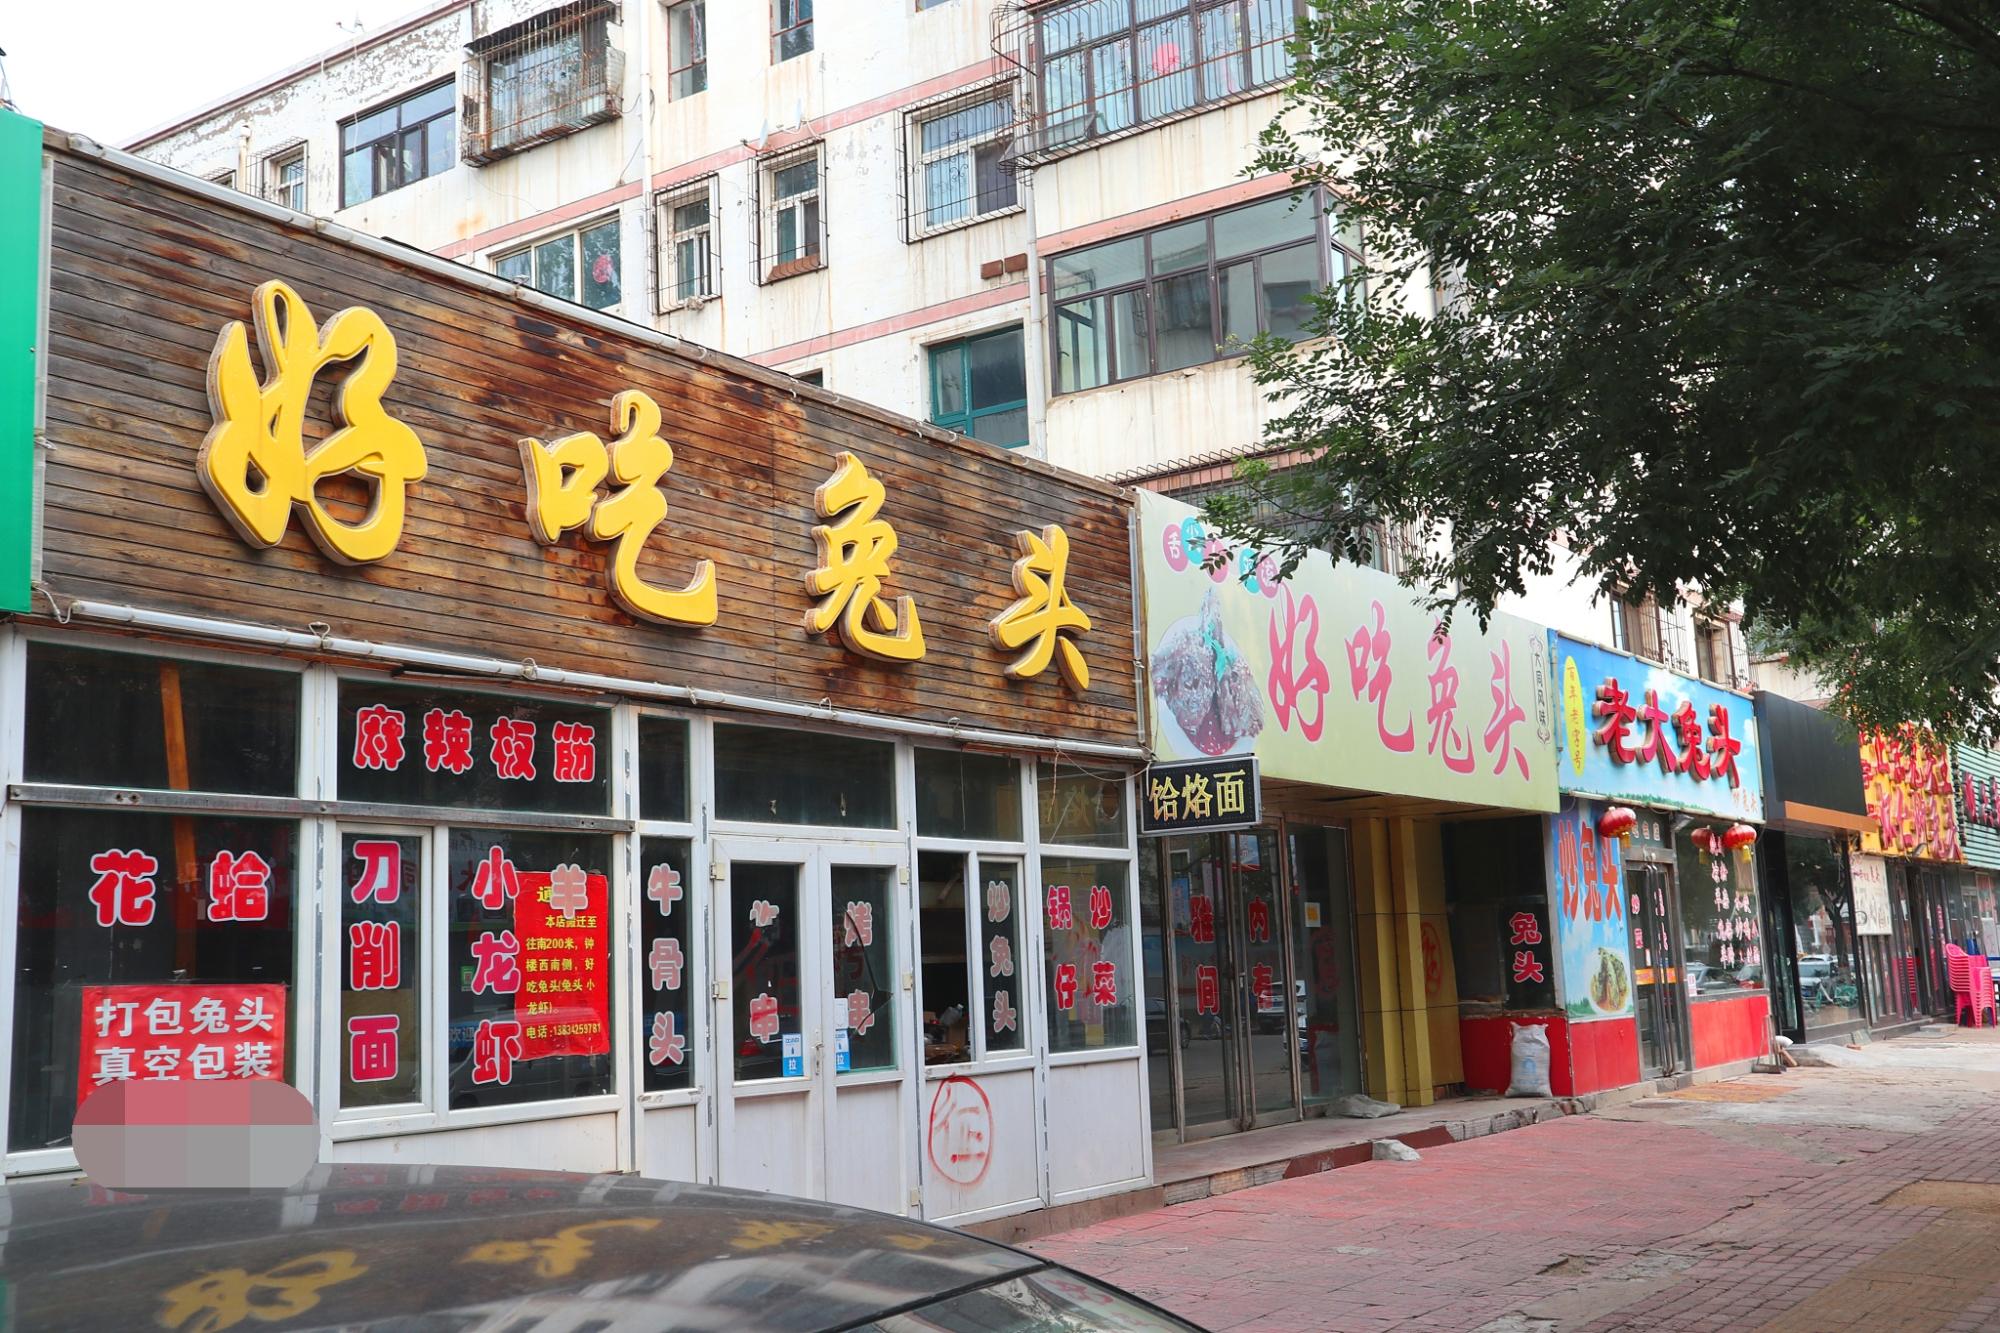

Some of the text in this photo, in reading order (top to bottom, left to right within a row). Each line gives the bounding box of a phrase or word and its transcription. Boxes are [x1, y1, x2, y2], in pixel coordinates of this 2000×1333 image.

[198, 278, 1092, 696] 好吃兔头
[1267, 583, 1531, 782] 好吃兔头
[1592, 676, 1742, 790] 老大兔头
[353, 703, 596, 783] 麻辣板筋
[1149, 768, 1246, 821] 饸烙面
[88, 848, 271, 927] 花蛤
[550, 863, 588, 919] 羊
[1558, 819, 1622, 922] 炒兔头
[347, 839, 401, 1083] 刀削面
[471, 845, 523, 1086] 小龙虾
[647, 862, 684, 1066] 牛骨头
[843, 901, 875, 1036] 烤串
[986, 880, 1018, 1033] 炒兔头
[1047, 884, 1078, 1011] 锅仔
[1089, 884, 1117, 1006] 炒菜
[1508, 911, 1545, 984] 兔头
[91, 1040, 274, 1087] 真空包装
[95, 996, 275, 1038] 打包兔头
